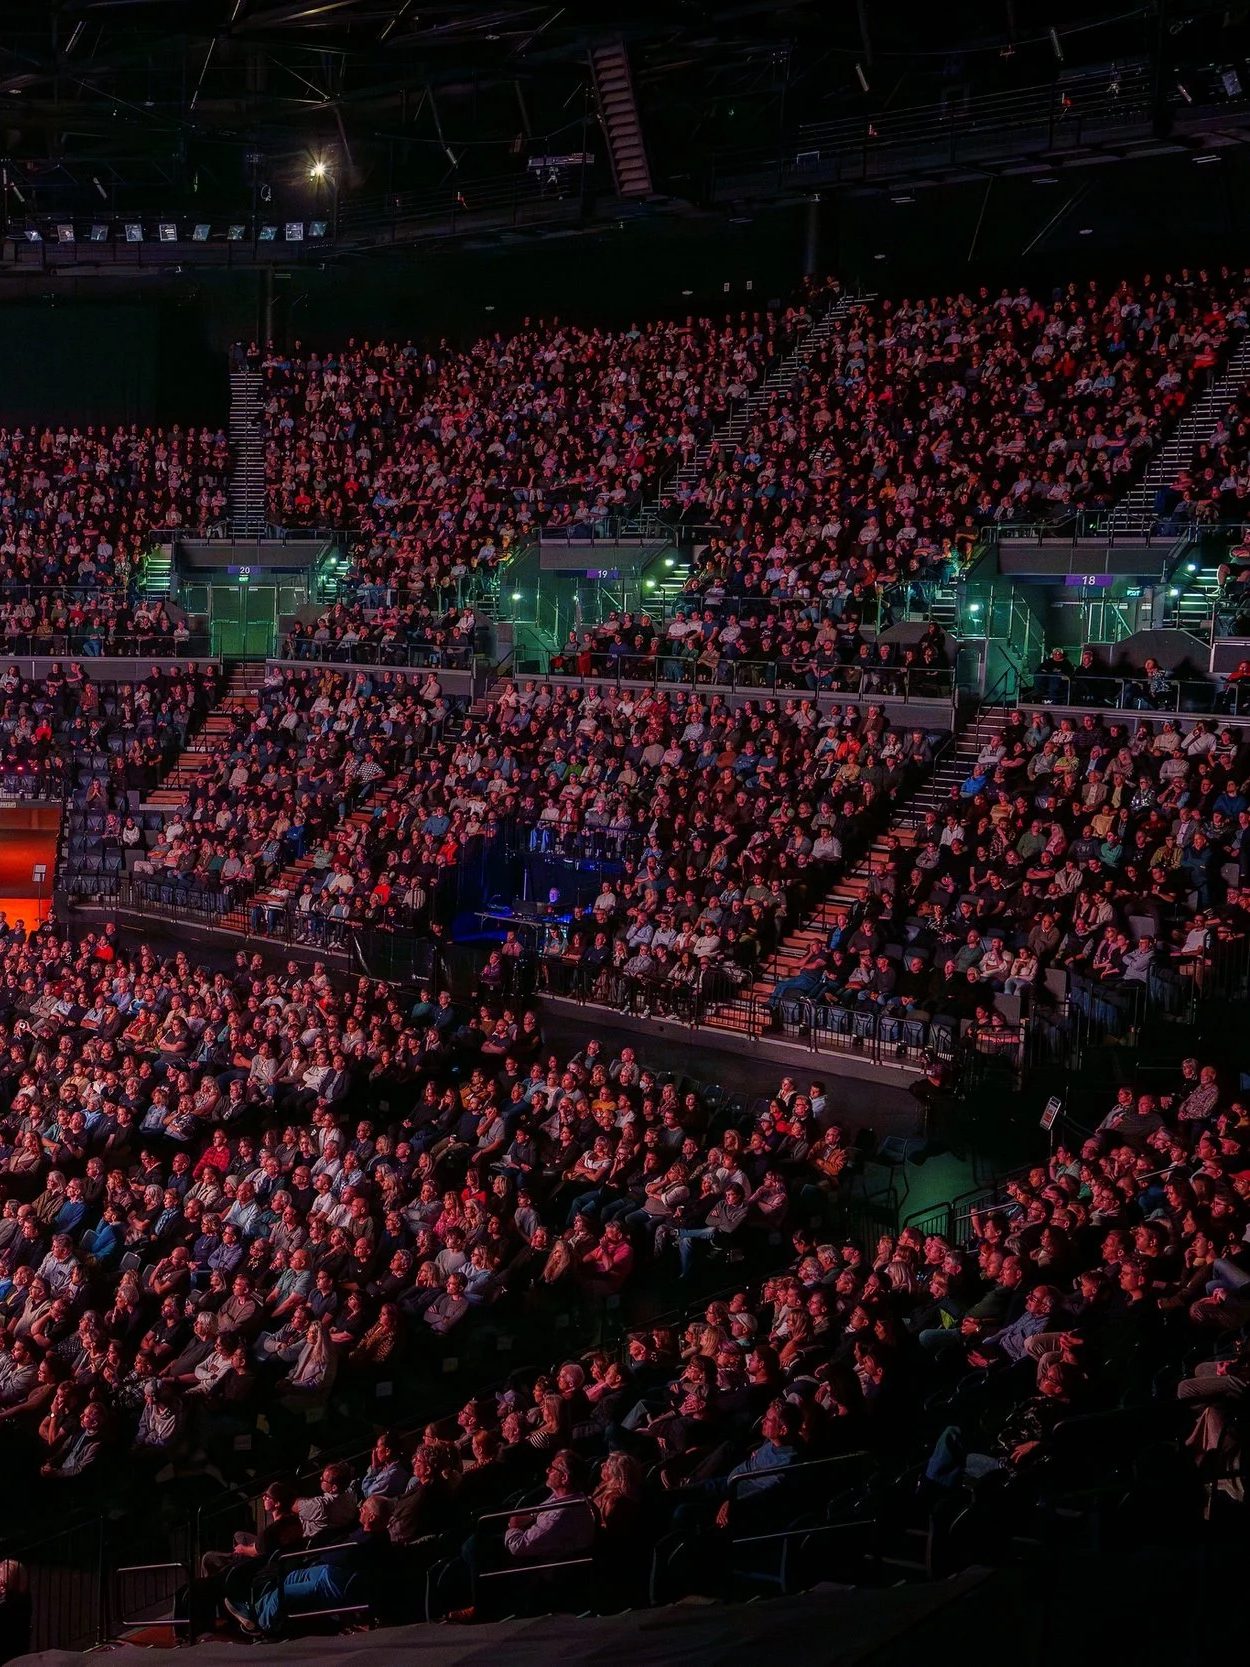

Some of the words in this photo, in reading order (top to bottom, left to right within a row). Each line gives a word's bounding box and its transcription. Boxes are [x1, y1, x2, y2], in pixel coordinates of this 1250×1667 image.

[239, 566, 251, 574] 20
[597, 570, 608, 578] 19
[1082, 575, 1096, 585] 18
